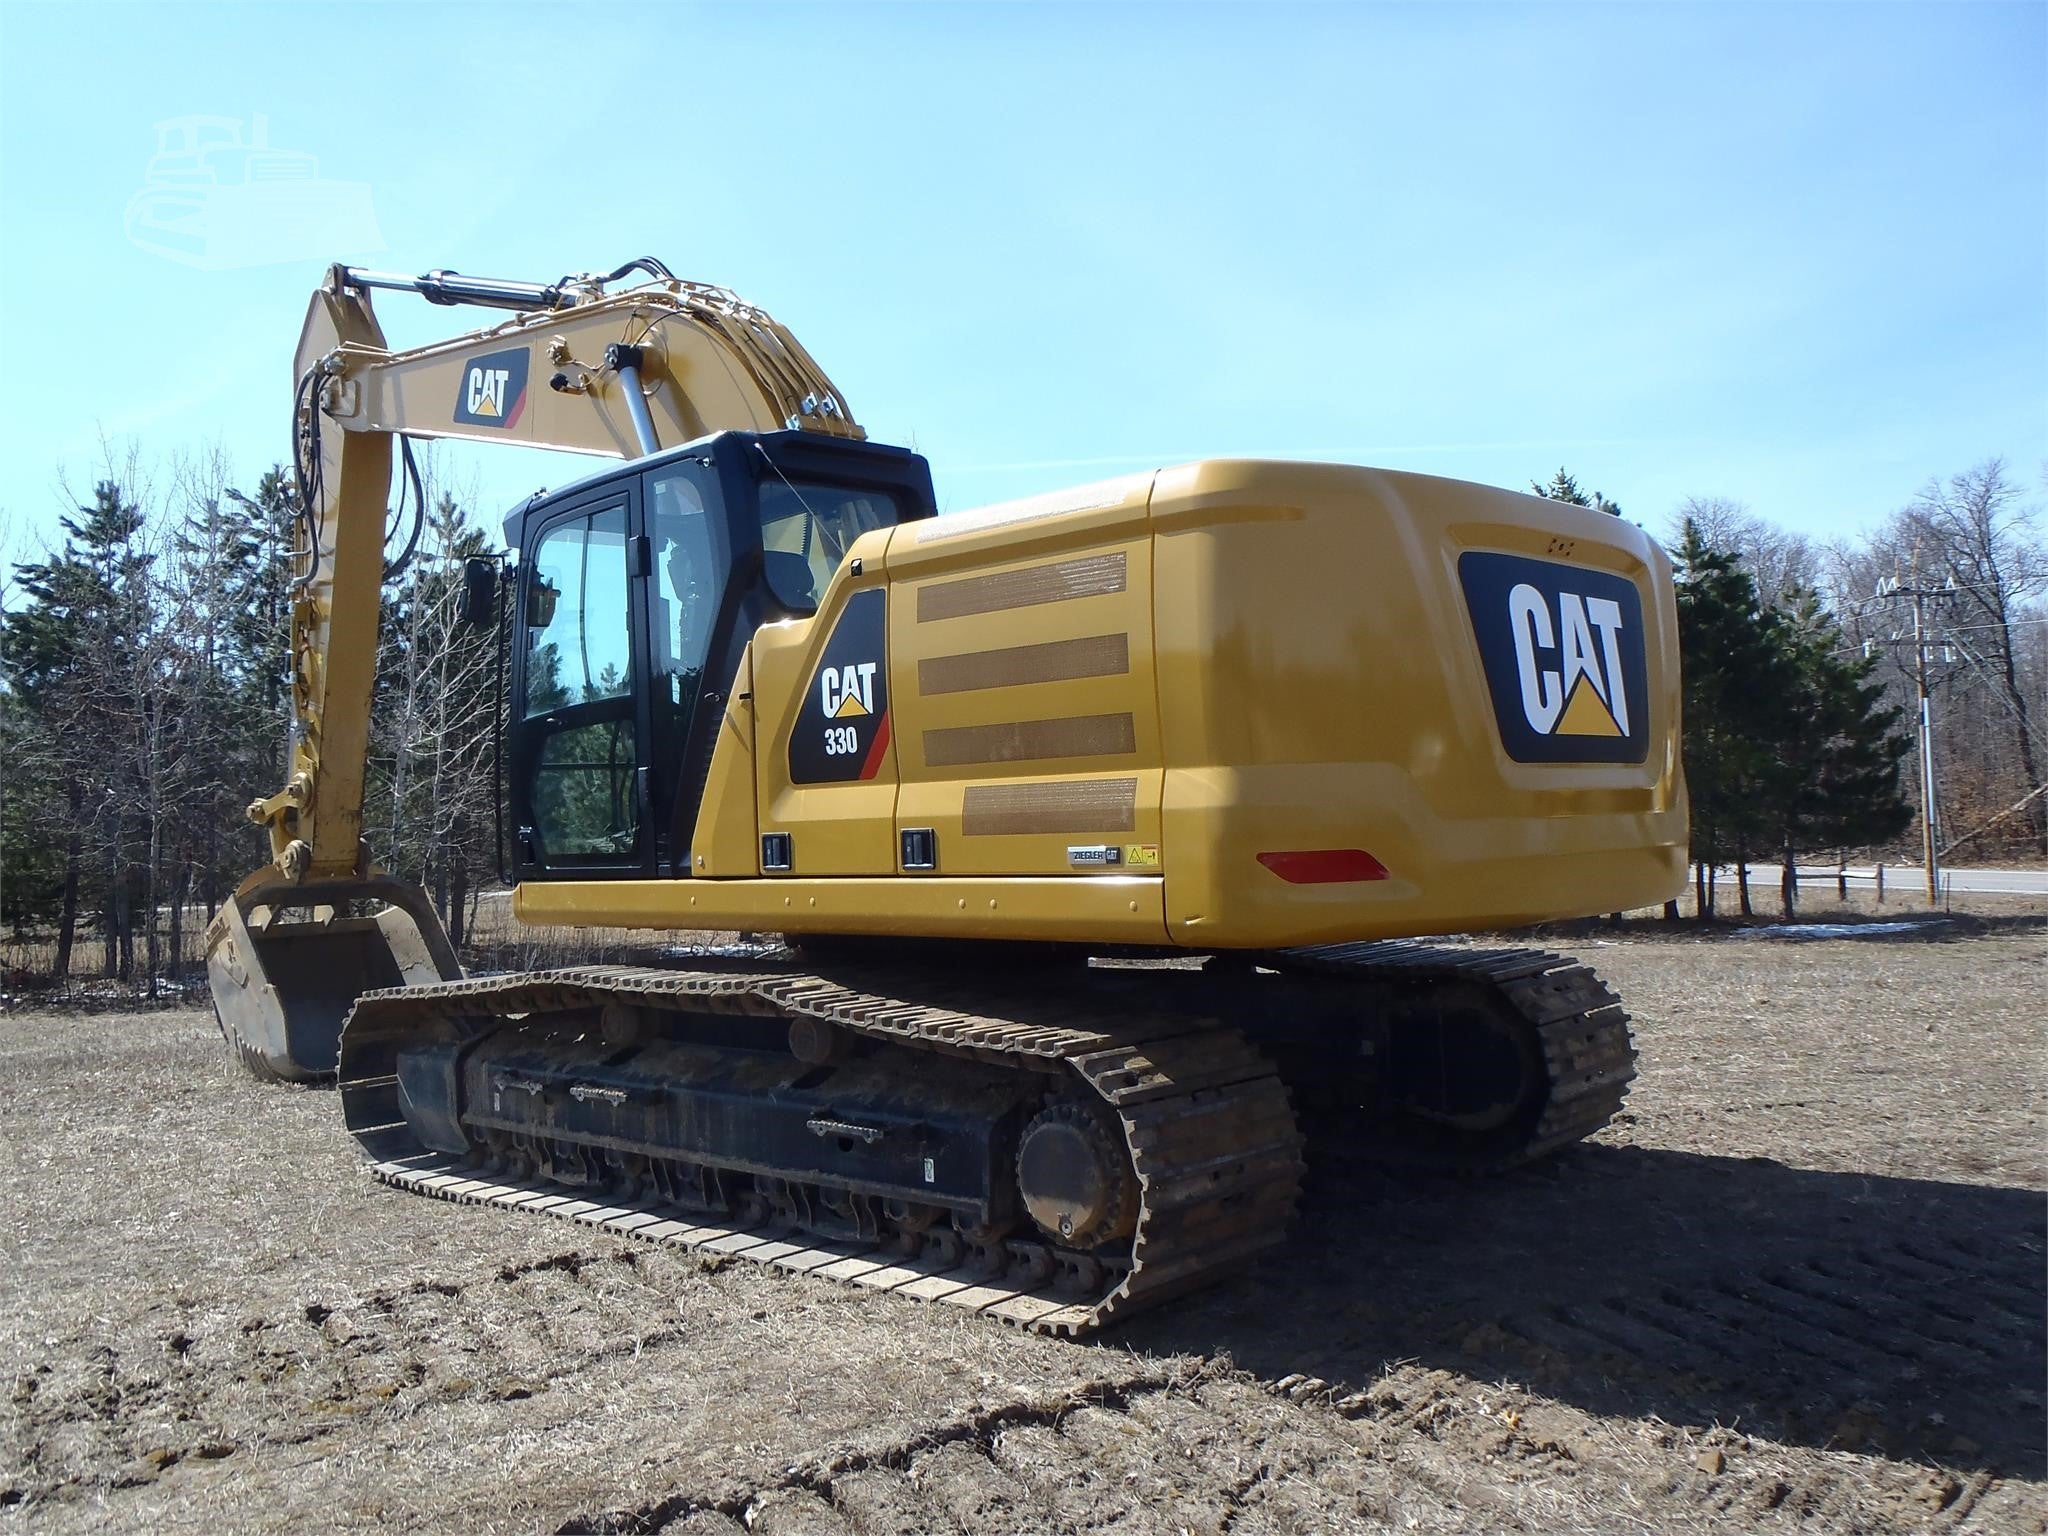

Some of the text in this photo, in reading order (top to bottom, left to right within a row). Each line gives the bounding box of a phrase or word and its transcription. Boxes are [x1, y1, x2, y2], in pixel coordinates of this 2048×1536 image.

[467, 367, 509, 417] CAT
[1508, 583, 1630, 737] CAT
[821, 662, 876, 719] CAT
[824, 726, 858, 755] 330
[1073, 850, 1104, 860] ZIEGLER
